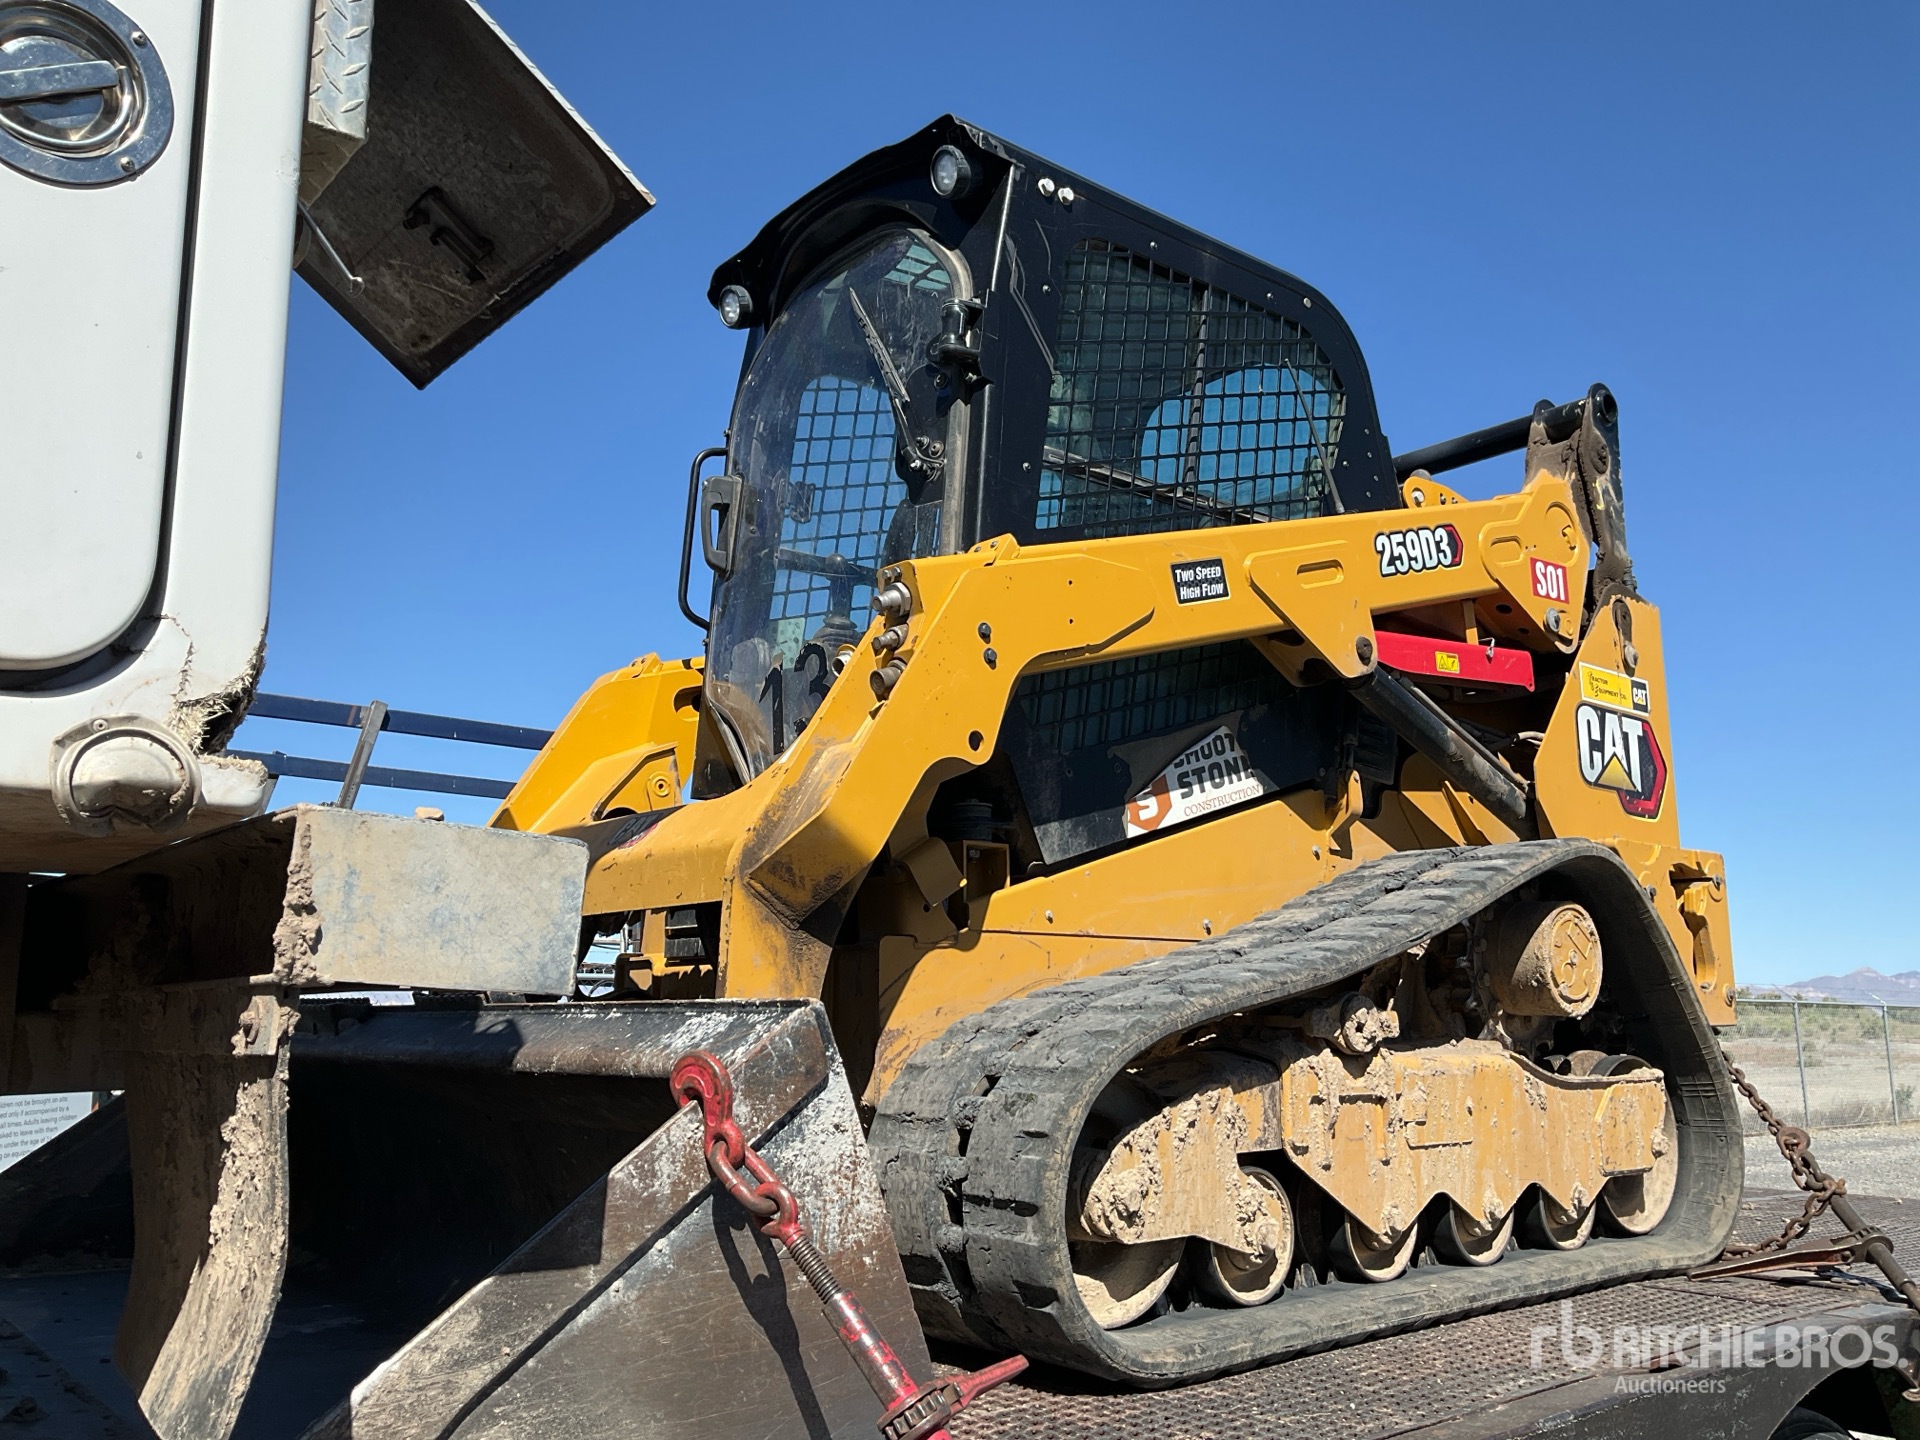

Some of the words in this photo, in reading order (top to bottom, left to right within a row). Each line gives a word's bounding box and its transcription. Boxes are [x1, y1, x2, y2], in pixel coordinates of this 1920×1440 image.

[1375, 527, 1453, 575] 259D3
[1632, 687, 1647, 706] CAT
[1577, 705, 1643, 793] CAT
[1184, 784, 1261, 817] CONSTRUCTION
[24, 1107, 58, 1117] accompanied
